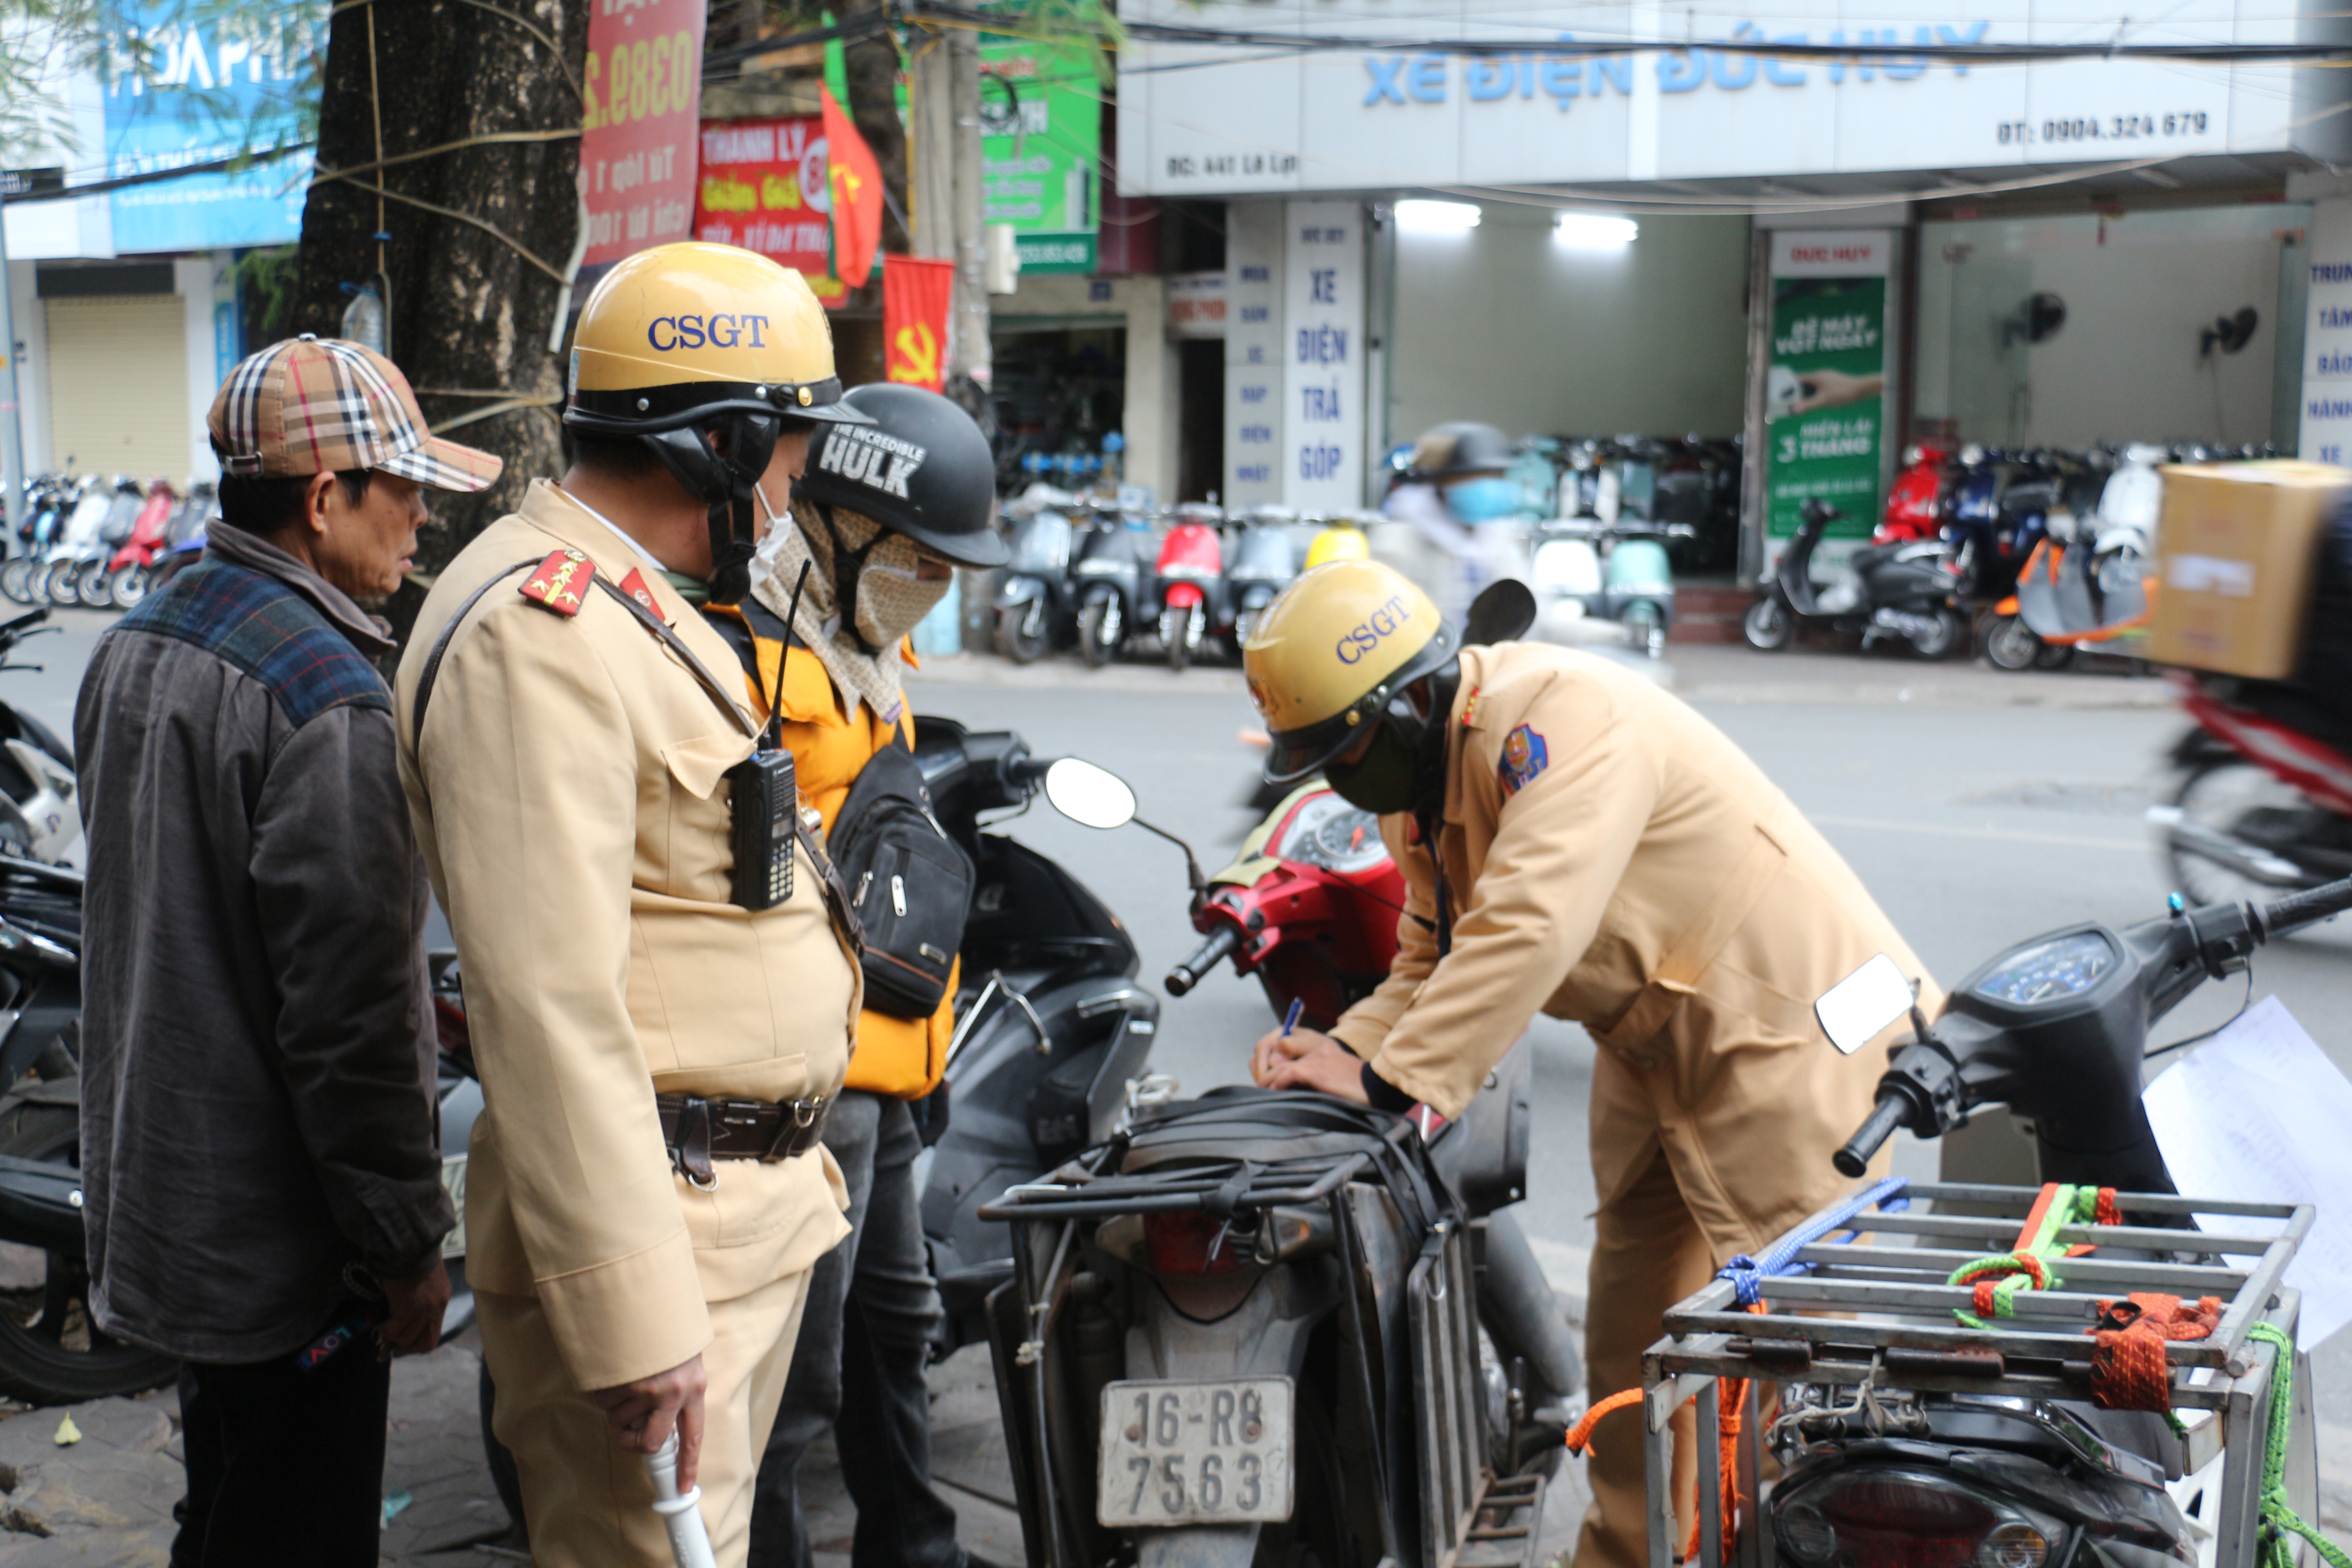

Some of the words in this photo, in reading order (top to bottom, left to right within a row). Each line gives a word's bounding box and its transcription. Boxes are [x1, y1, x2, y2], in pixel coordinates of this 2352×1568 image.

[1363, 51, 1447, 106] XE
[1466, 33, 1632, 111] ĐIỆN
[1656, 21, 1808, 93] ĐỨC
[1830, 21, 1990, 84] HUY
[1309, 268, 1336, 304] XE
[648, 314, 768, 351] CSGT
[1296, 323, 1347, 369] ĐIỆN
[1302, 377, 1340, 422] TRẢ
[819, 432, 917, 500] HULK
[852, 426, 926, 462] INCREDIBLE
[1299, 439, 1342, 480] GÓP
[1776, 435, 1797, 464] 3
[1336, 595, 1411, 665] CSGT
[1133, 1388, 1263, 1448] 16-R8
[1127, 1452, 1262, 1515] 7563
